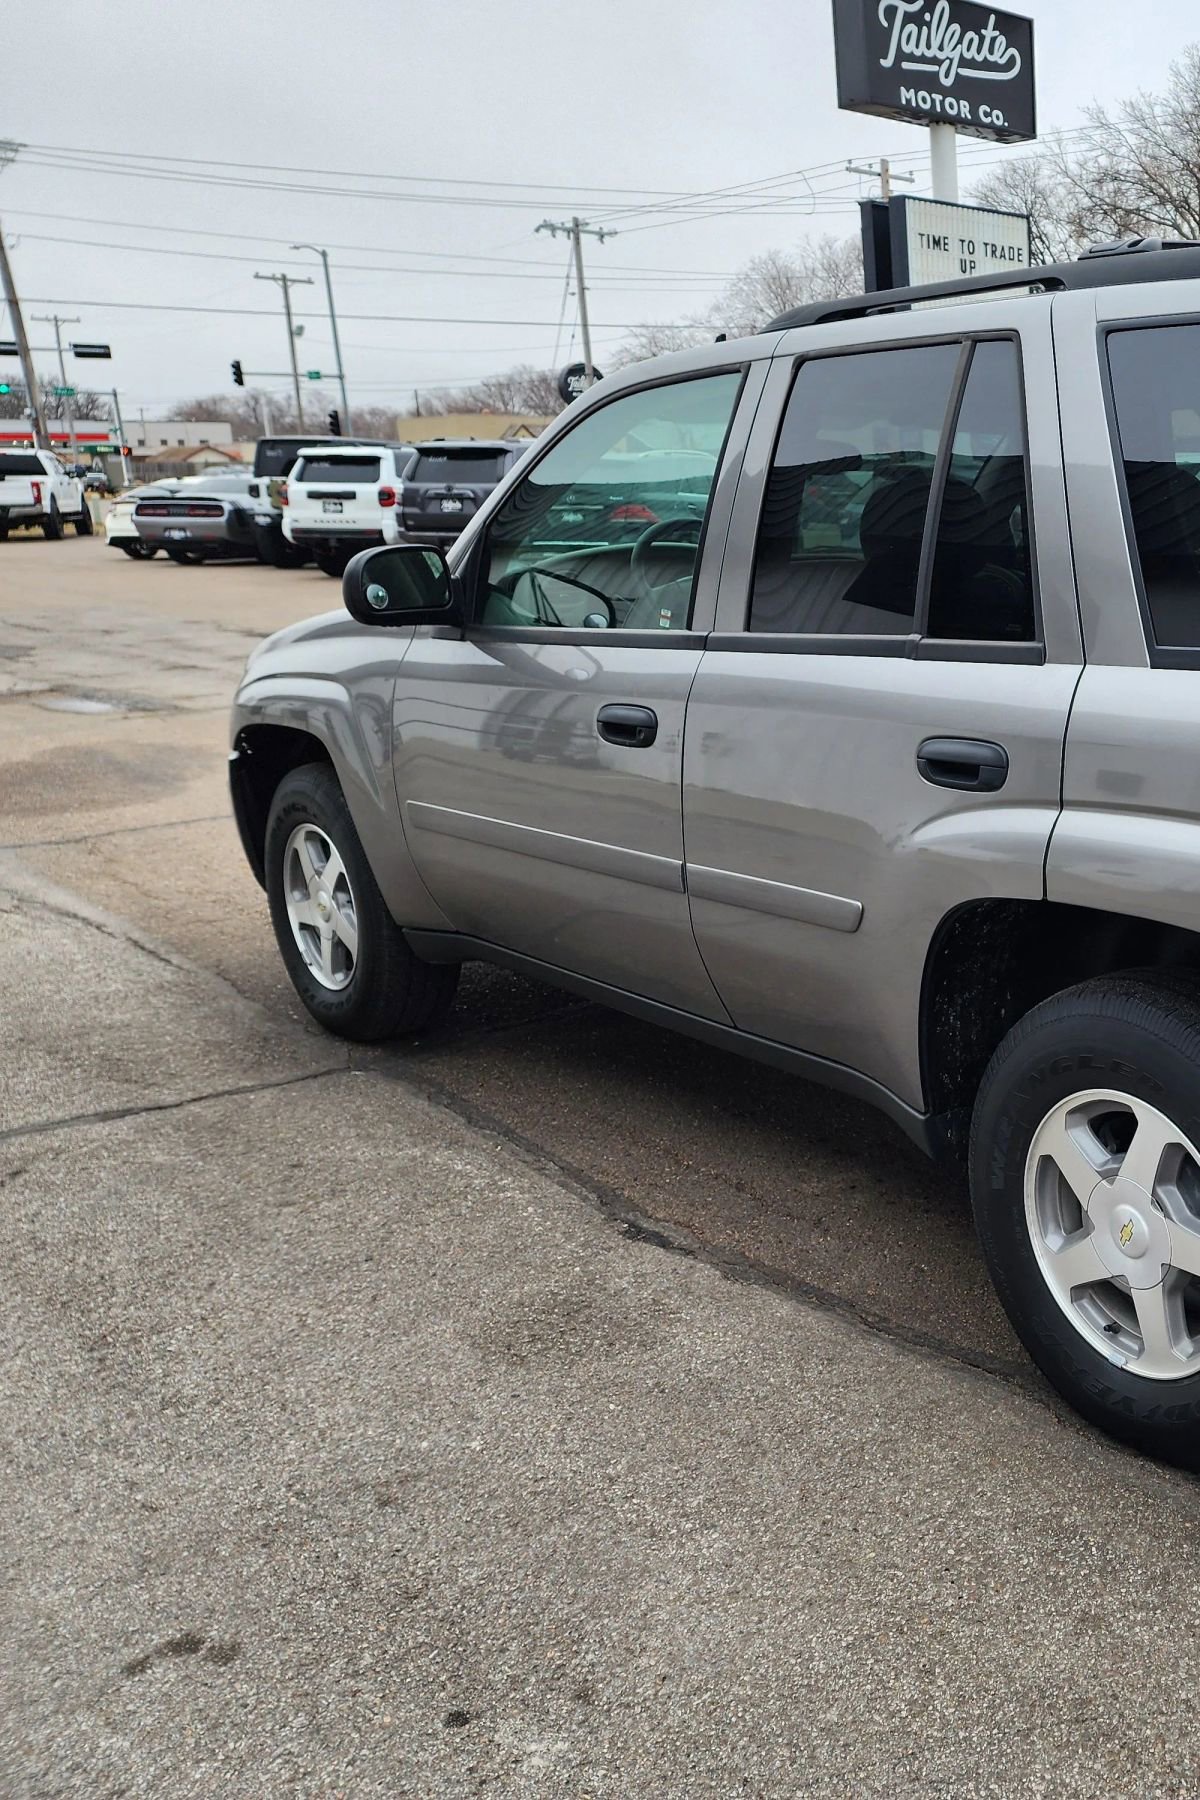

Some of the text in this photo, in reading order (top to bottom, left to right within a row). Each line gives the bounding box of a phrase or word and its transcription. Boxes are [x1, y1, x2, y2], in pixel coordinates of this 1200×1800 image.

[878, 0, 1021, 87] Tailgate
[900, 86, 972, 119] MOTOR
[919, 233, 1023, 262] TIME TO TRADE
[960, 259, 976, 275] UP
